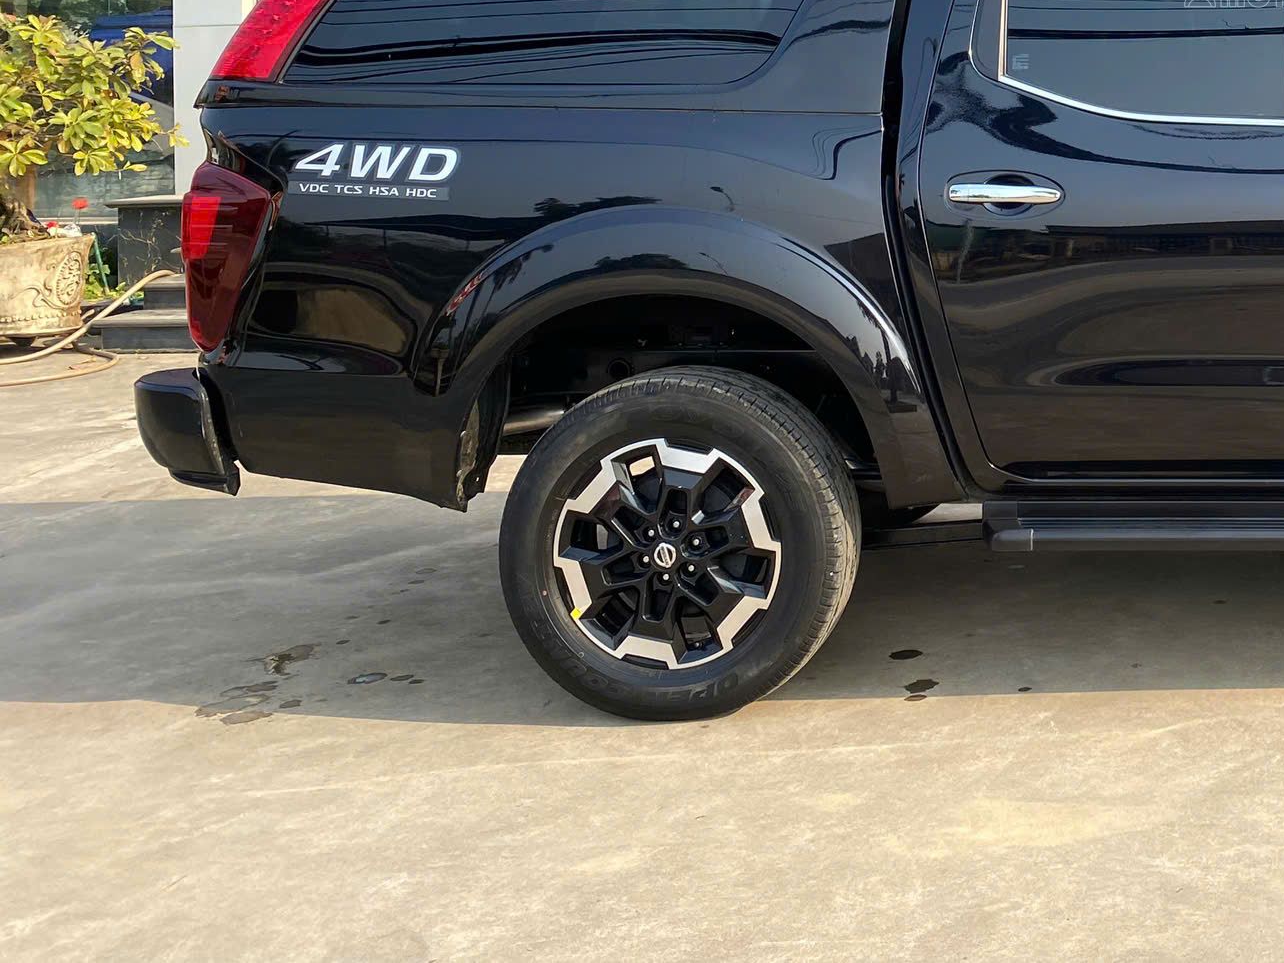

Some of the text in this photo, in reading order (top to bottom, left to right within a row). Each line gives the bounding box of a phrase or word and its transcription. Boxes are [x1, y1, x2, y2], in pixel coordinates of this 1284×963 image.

[294, 143, 459, 182] 4WD
[299, 183, 437, 198] VDC TCS HSA HDC
